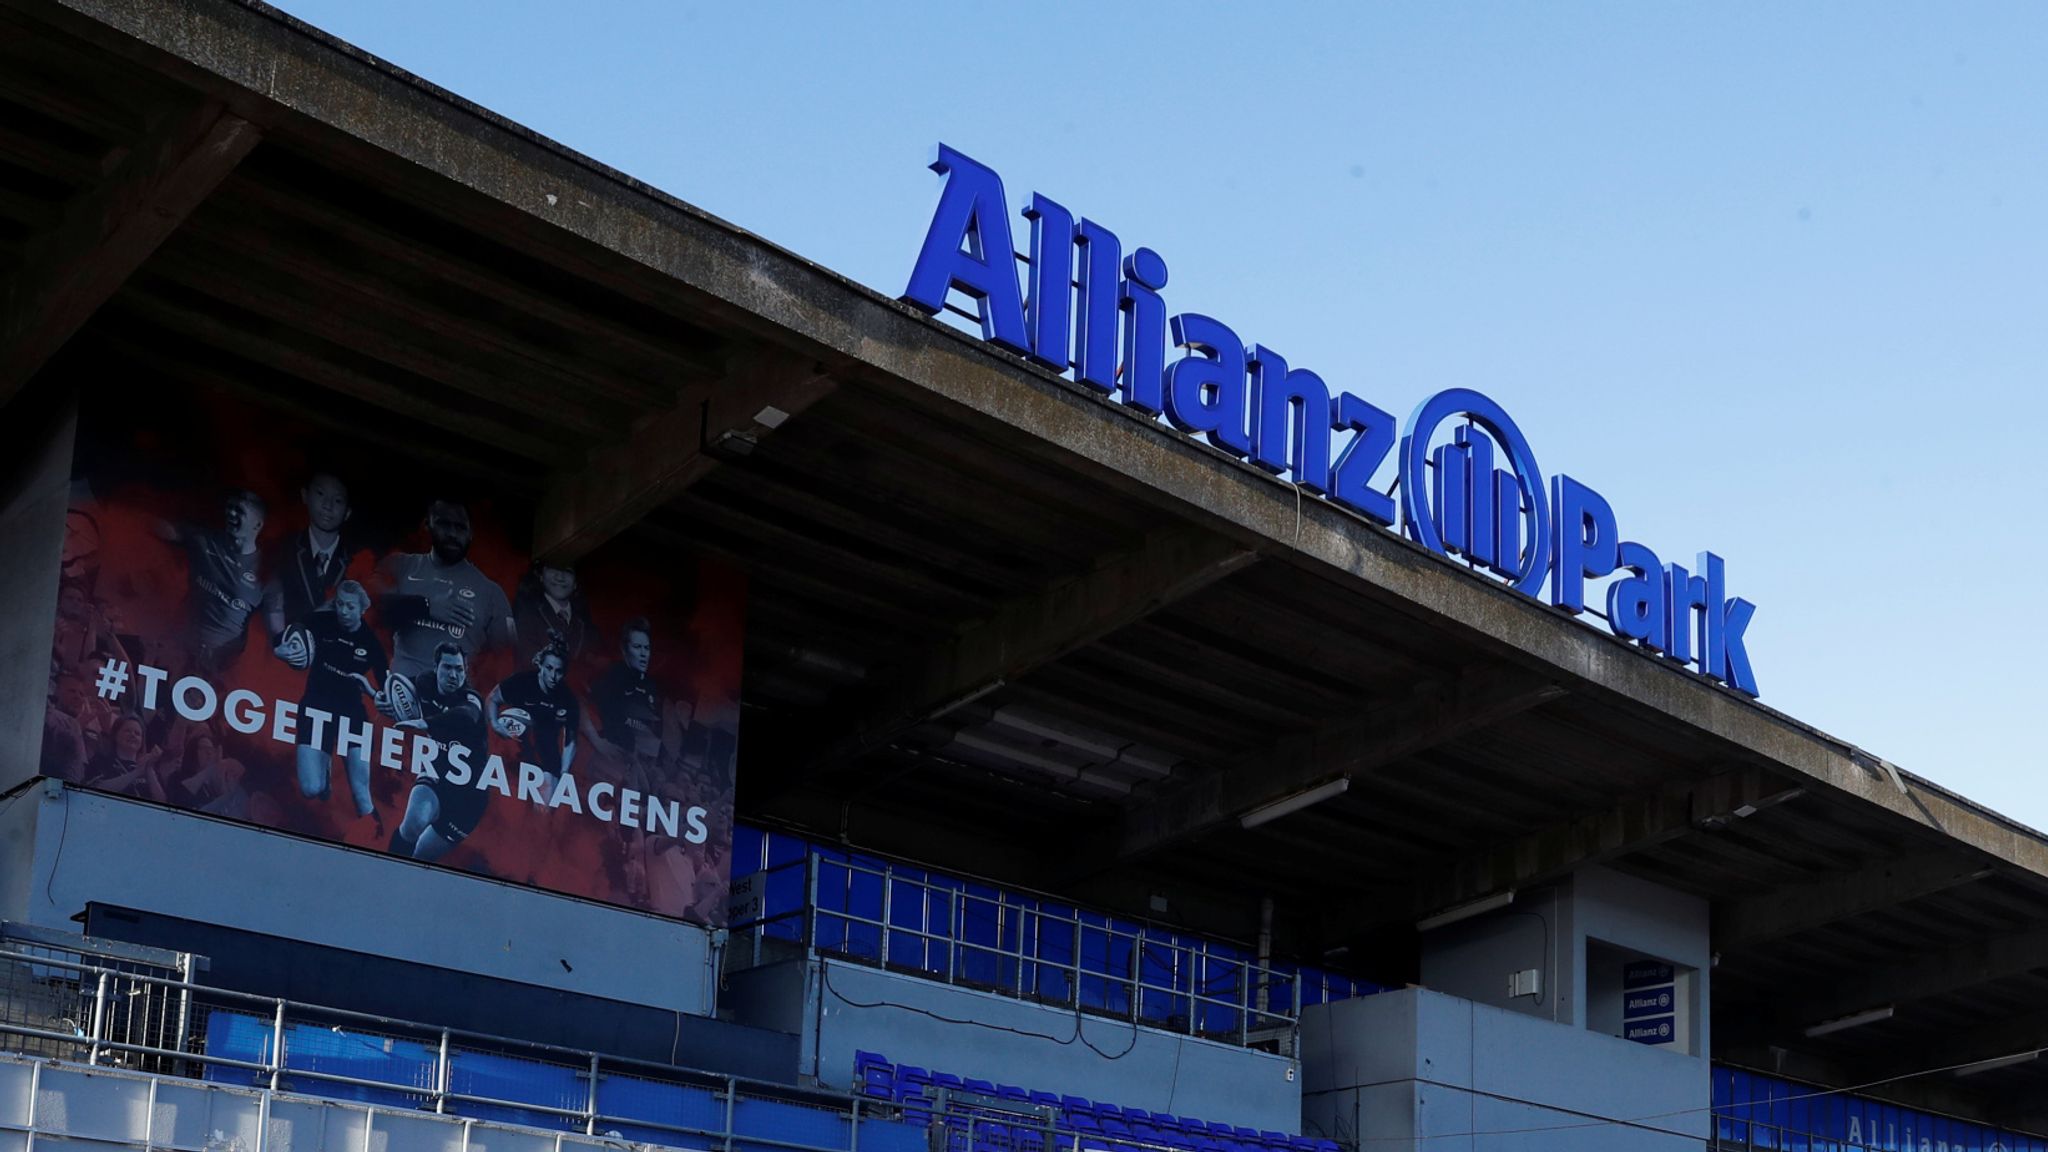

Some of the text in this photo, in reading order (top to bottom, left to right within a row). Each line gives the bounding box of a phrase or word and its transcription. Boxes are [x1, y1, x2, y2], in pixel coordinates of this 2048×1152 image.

[905, 142, 1760, 698] Allianz Park
[95, 655, 710, 845] #TOGETHERSARACENS
[1628, 1027, 1658, 1039] Allianz
[1629, 998, 1657, 1009] Allianz
